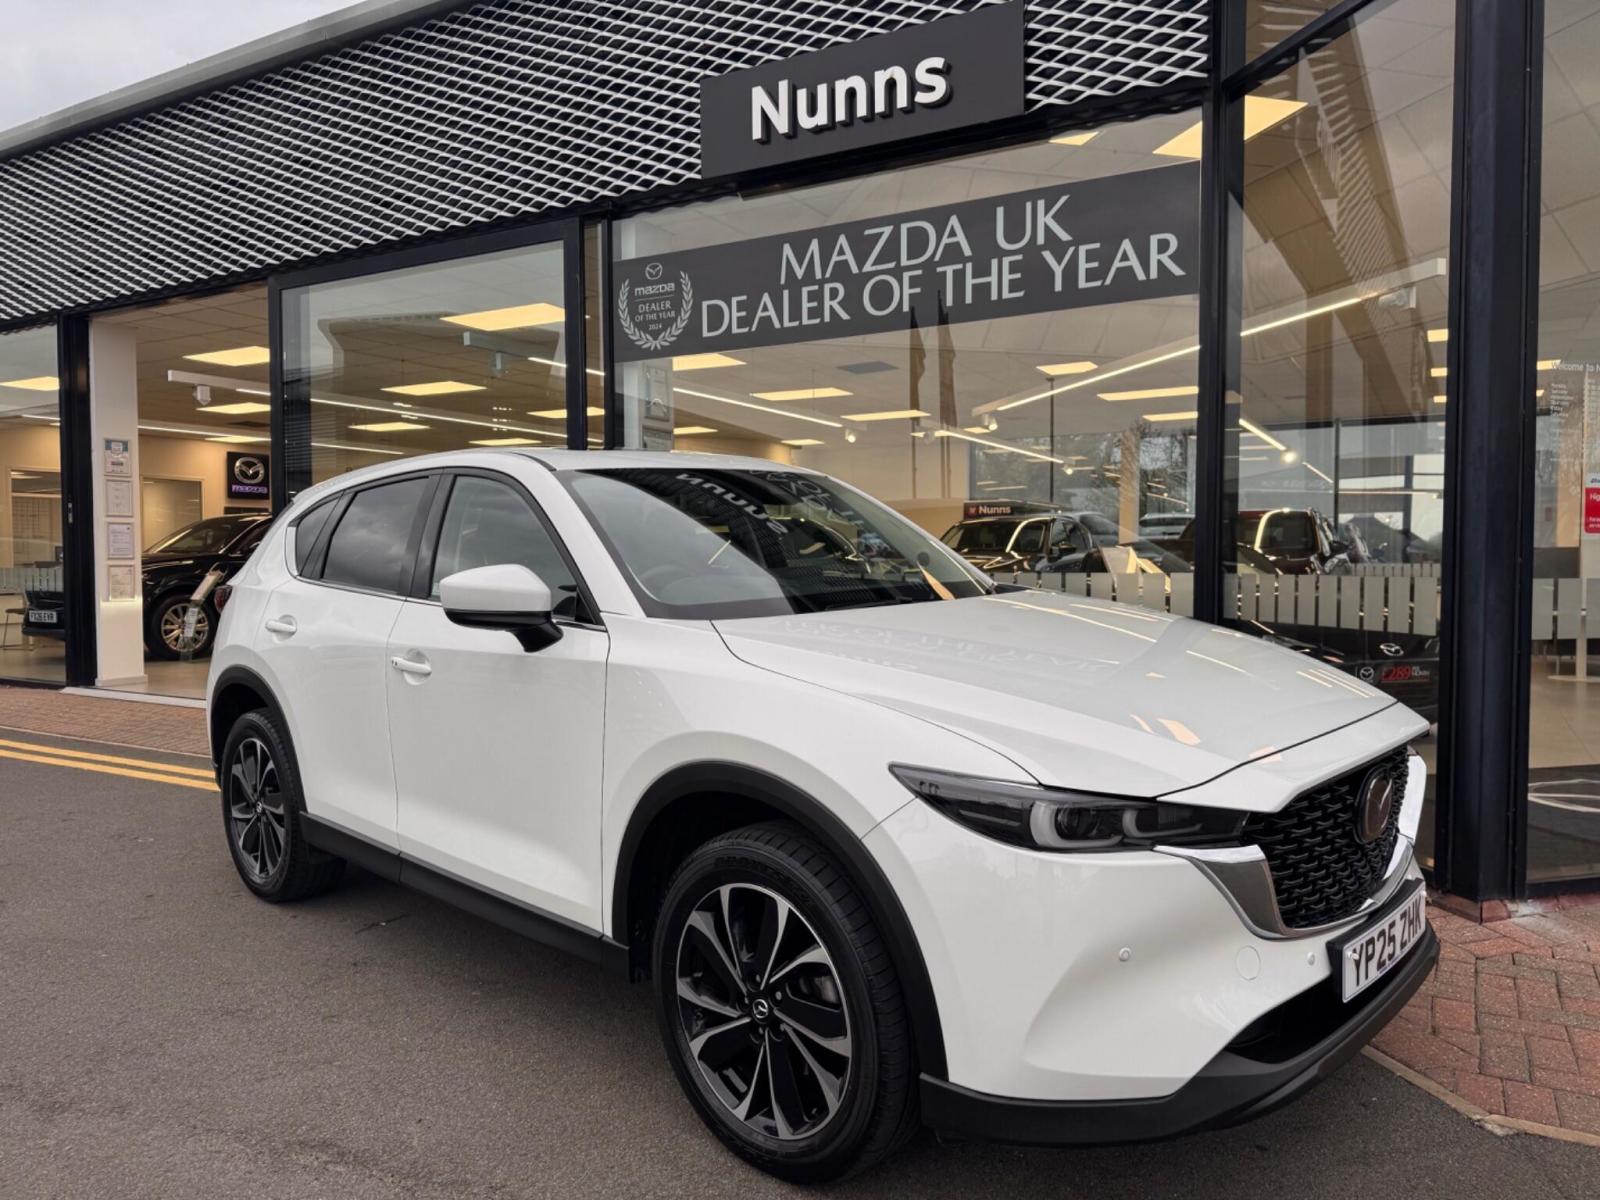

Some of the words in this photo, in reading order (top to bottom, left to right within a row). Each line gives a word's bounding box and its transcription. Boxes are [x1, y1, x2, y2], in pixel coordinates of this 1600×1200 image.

[751, 56, 949, 142] Nunns
[780, 214, 972, 285] MAZDA
[996, 195, 1072, 249] UK
[634, 314, 643, 322] OF
[645, 312, 657, 321] THE
[659, 310, 676, 319] YEAR
[638, 300, 671, 313] DEALER
[702, 282, 850, 338] DEALER
[863, 272, 923, 316] OF
[937, 253, 1025, 307] THE
[1041, 232, 1186, 291] YEAR
[979, 505, 1011, 514] Nunns
[1352, 920, 1396, 987] YP25
[1400, 895, 1421, 950] ZHK
